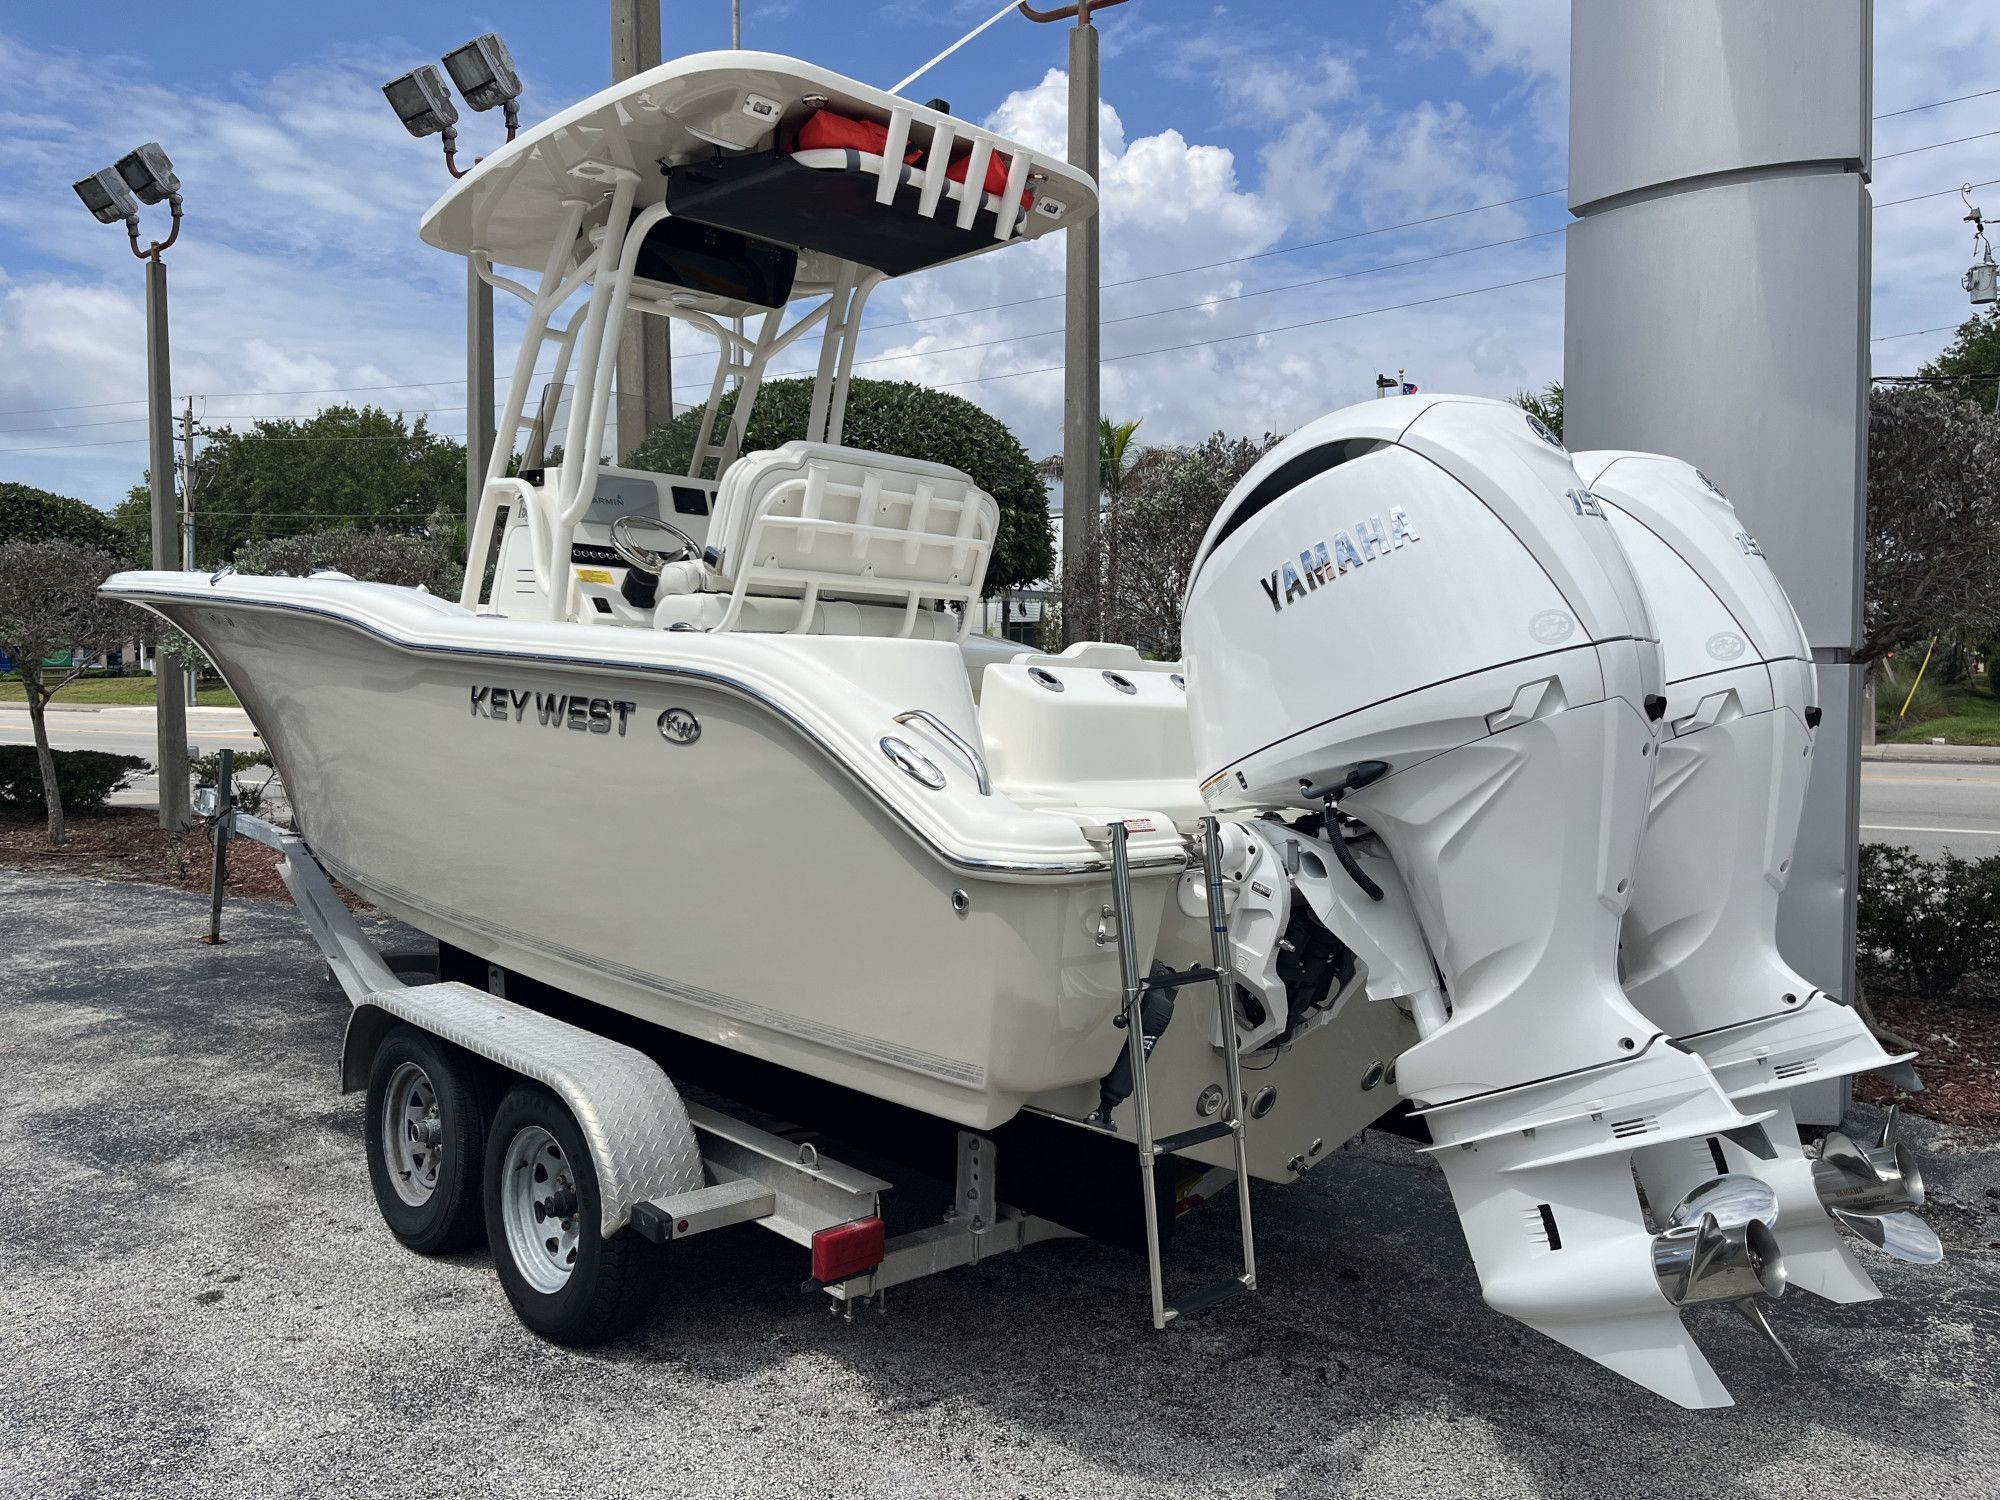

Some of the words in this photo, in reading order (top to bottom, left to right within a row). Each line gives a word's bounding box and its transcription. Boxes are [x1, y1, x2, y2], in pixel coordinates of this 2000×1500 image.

[592, 493, 625, 507] ARMIN
[1260, 505, 1420, 613] YAMAHA
[470, 685, 531, 723] KEY
[535, 691, 637, 737] WEST
